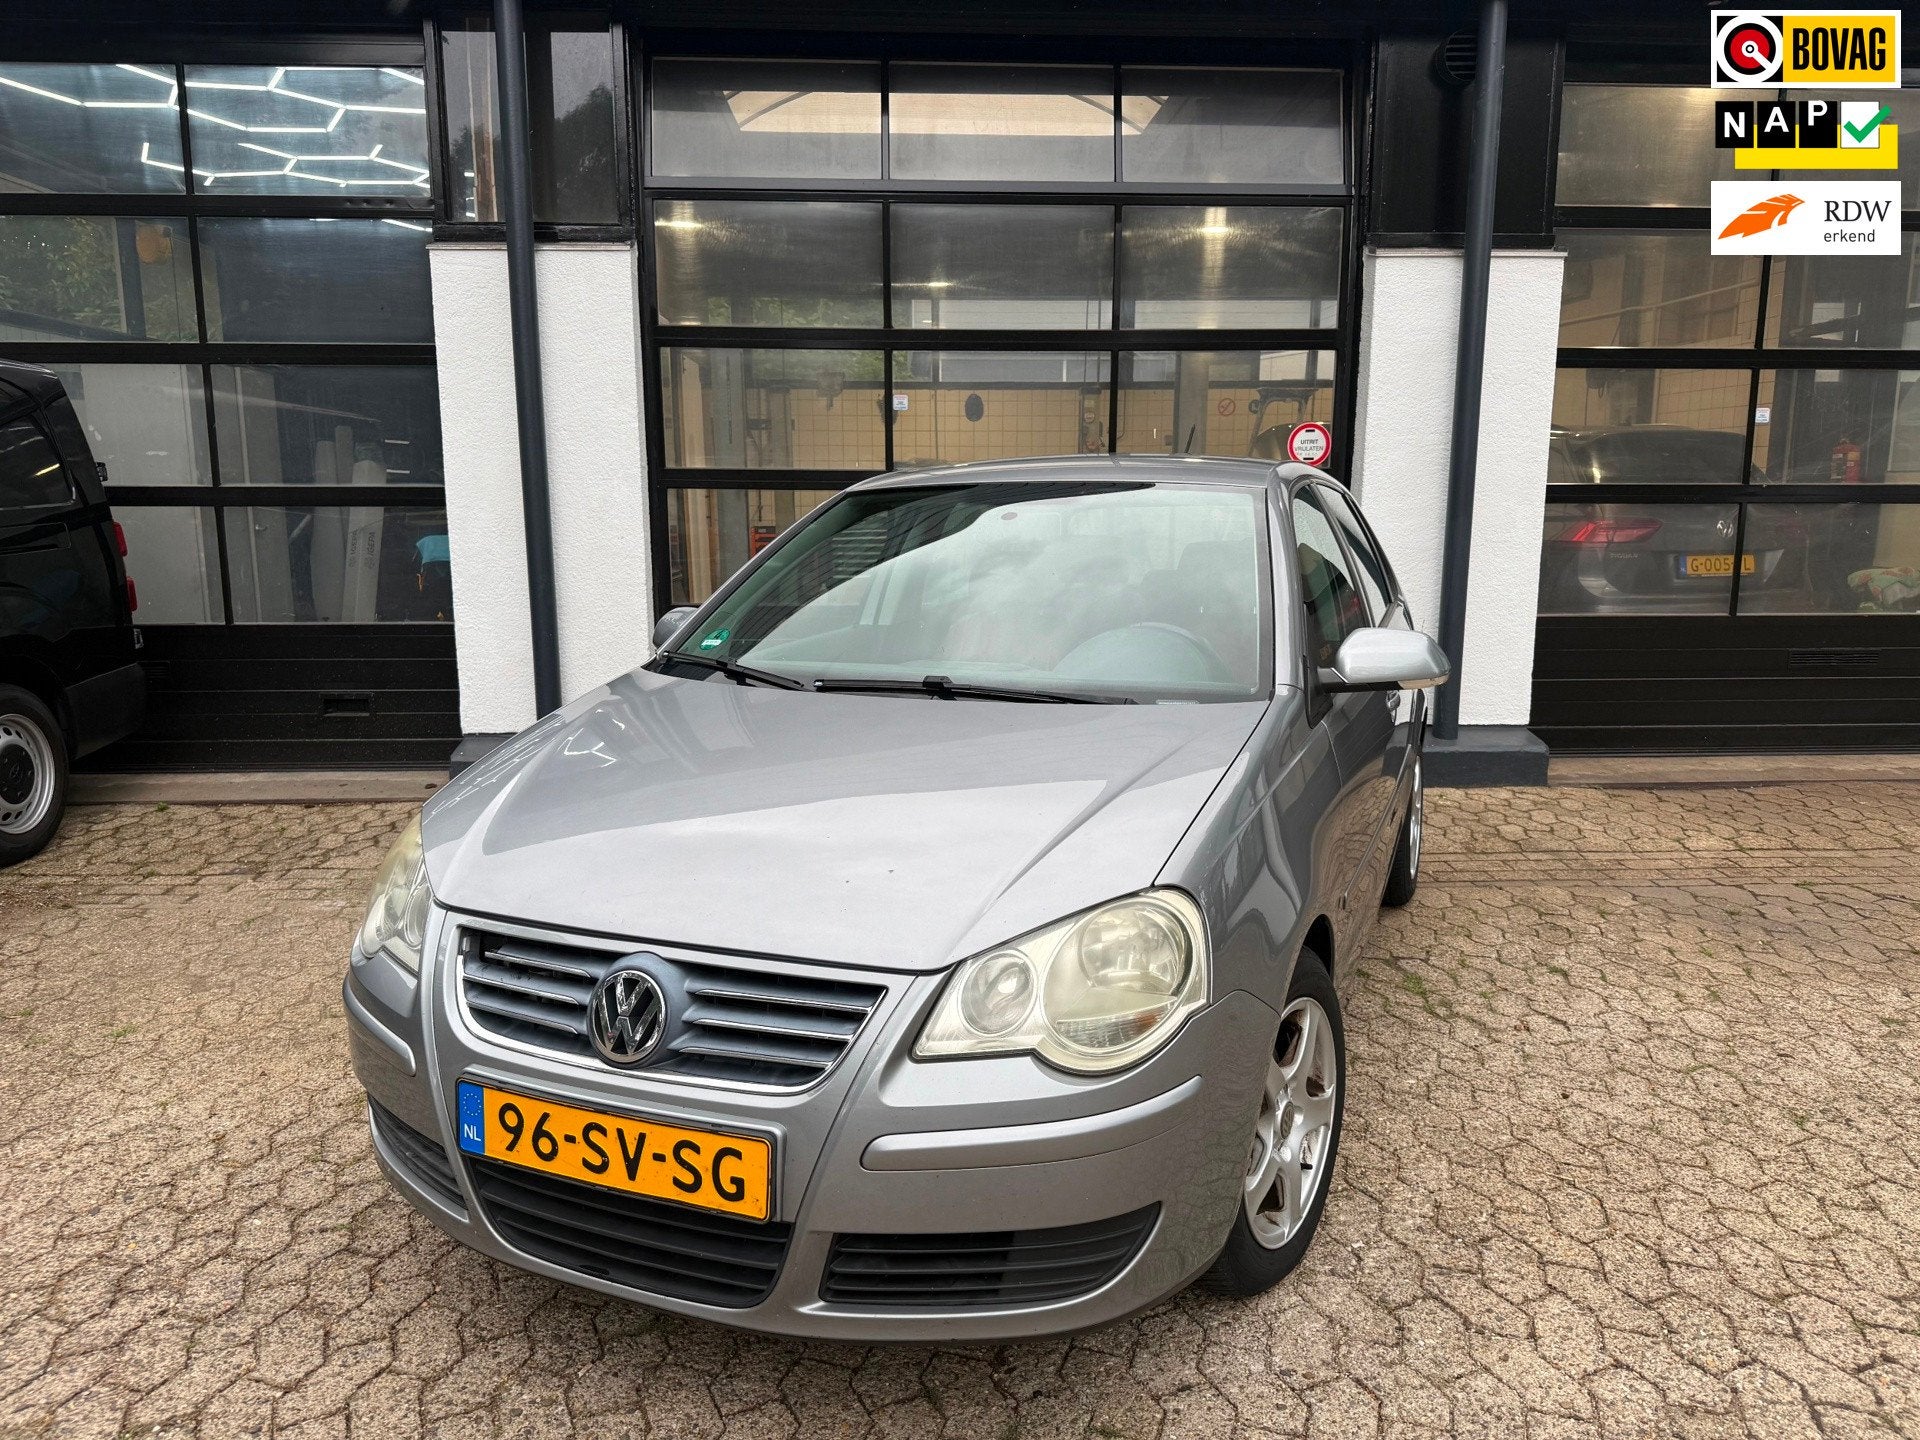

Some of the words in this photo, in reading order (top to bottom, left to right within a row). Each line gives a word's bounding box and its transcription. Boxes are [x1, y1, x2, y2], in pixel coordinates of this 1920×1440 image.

[1690, 557, 1751, 572] G-005-L
[463, 1123, 482, 1142] NL
[498, 1102, 746, 1202] 96-SV-SG
